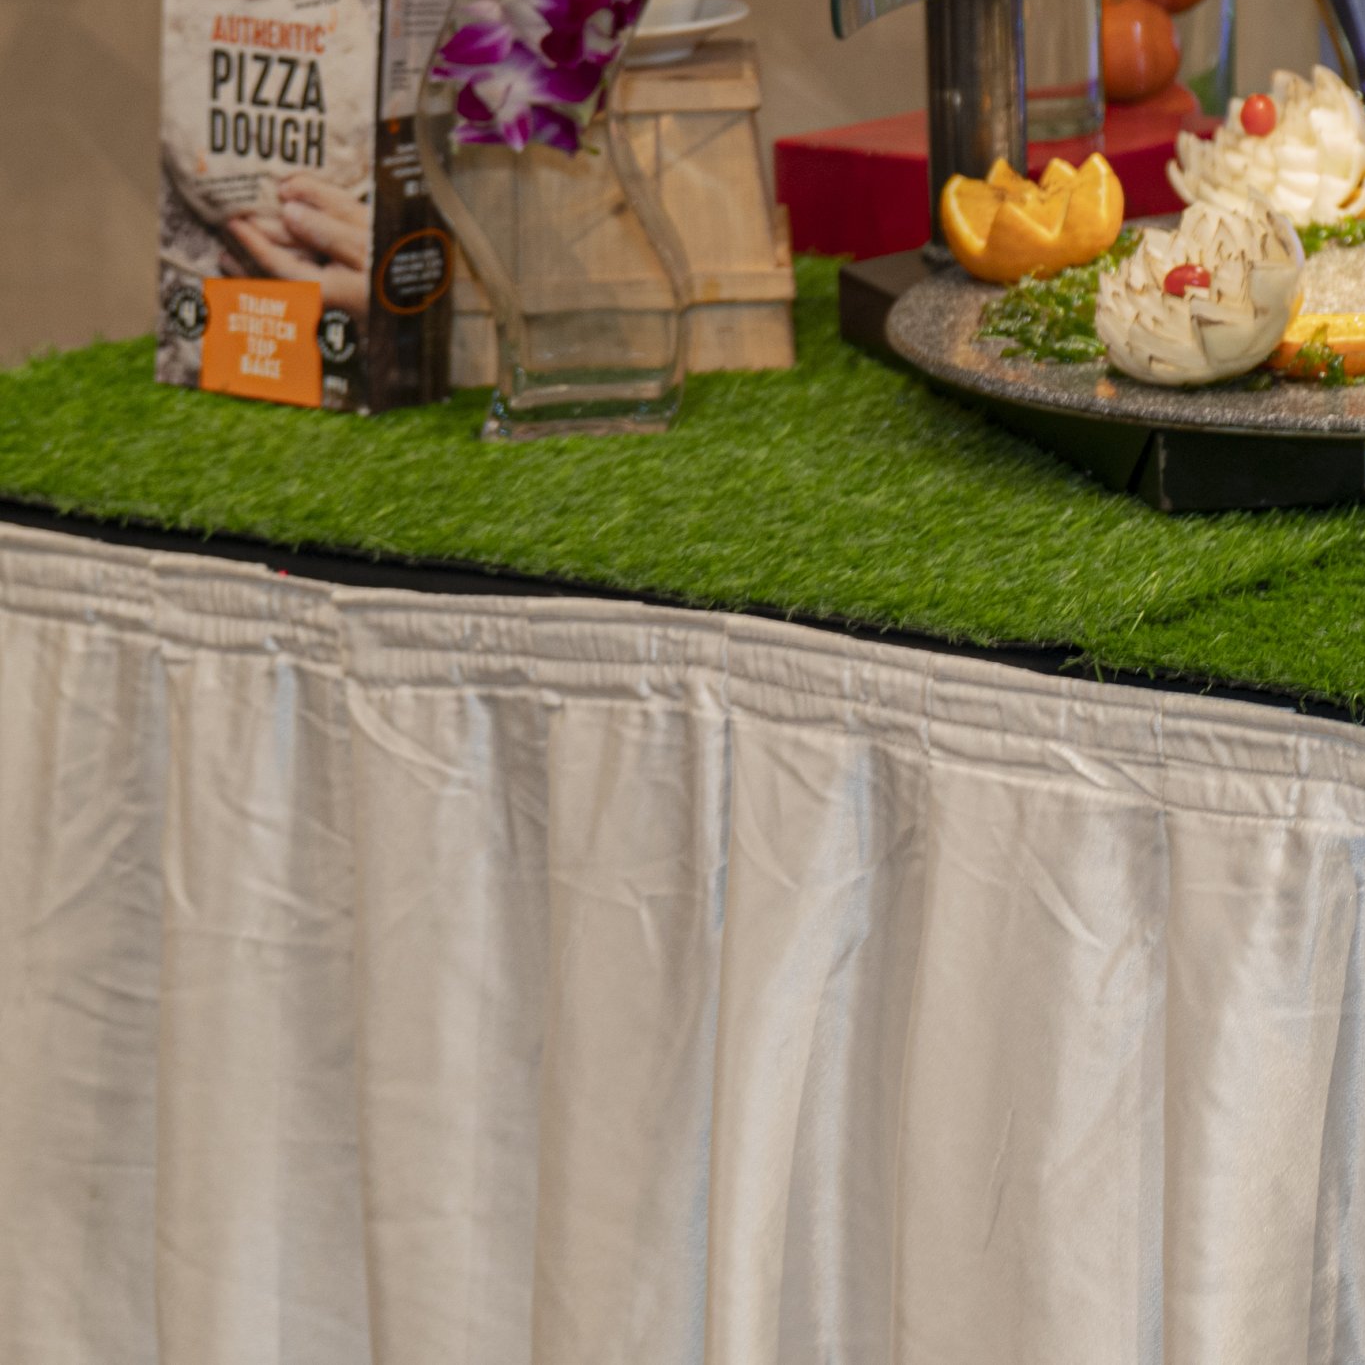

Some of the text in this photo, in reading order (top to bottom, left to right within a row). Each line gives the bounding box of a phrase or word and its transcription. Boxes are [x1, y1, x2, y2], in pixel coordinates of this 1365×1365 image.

[211, 14, 325, 55] AUTHENTIC
[211, 48, 325, 115] PIZZA
[210, 108, 324, 169] DOUGH
